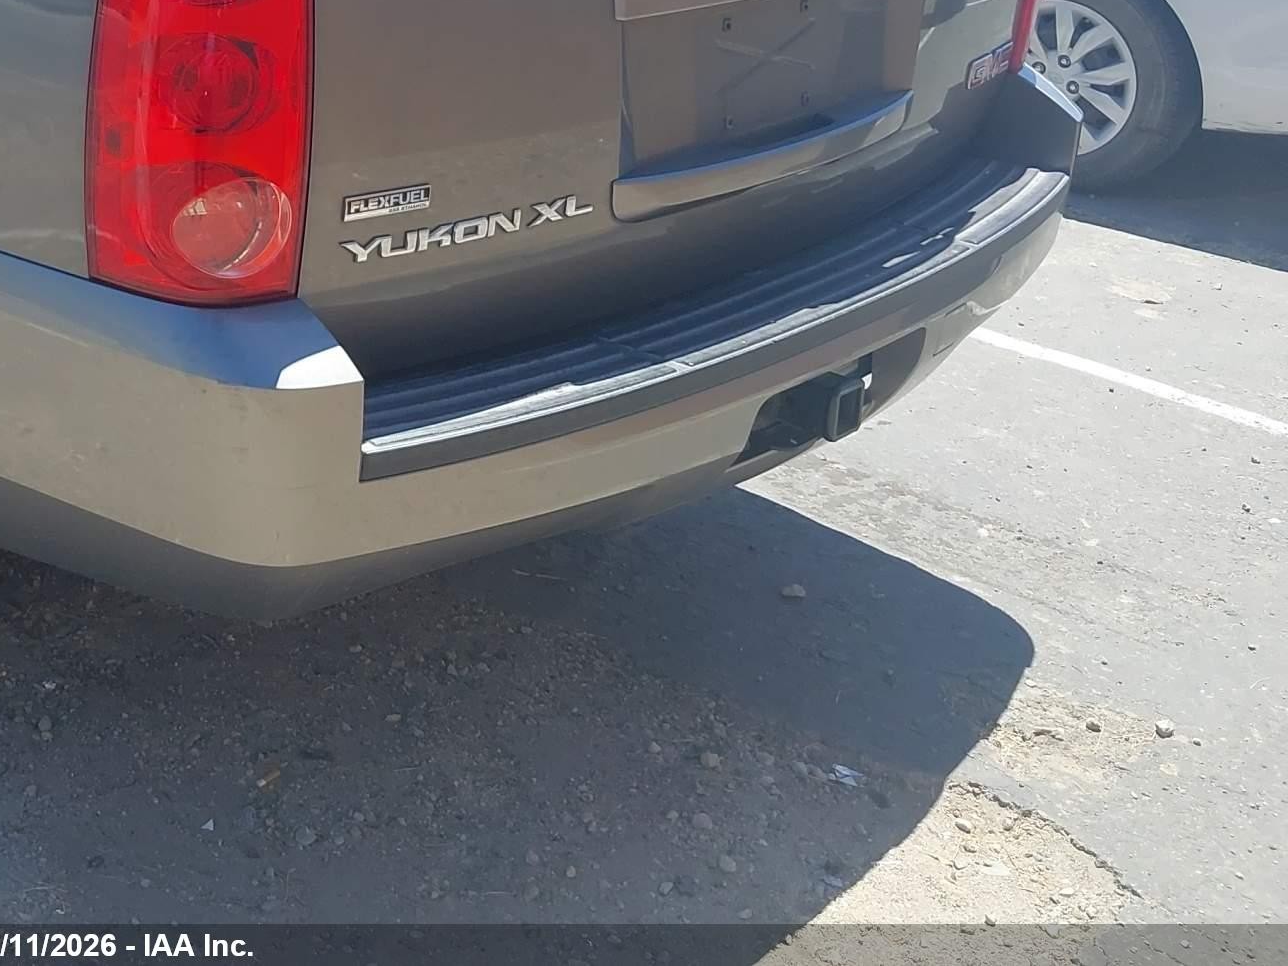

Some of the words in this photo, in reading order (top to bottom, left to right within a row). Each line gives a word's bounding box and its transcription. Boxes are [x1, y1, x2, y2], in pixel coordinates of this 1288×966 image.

[348, 188, 430, 214] FLEXFUEL
[339, 209, 522, 264] YUKON
[527, 194, 594, 228] XL
